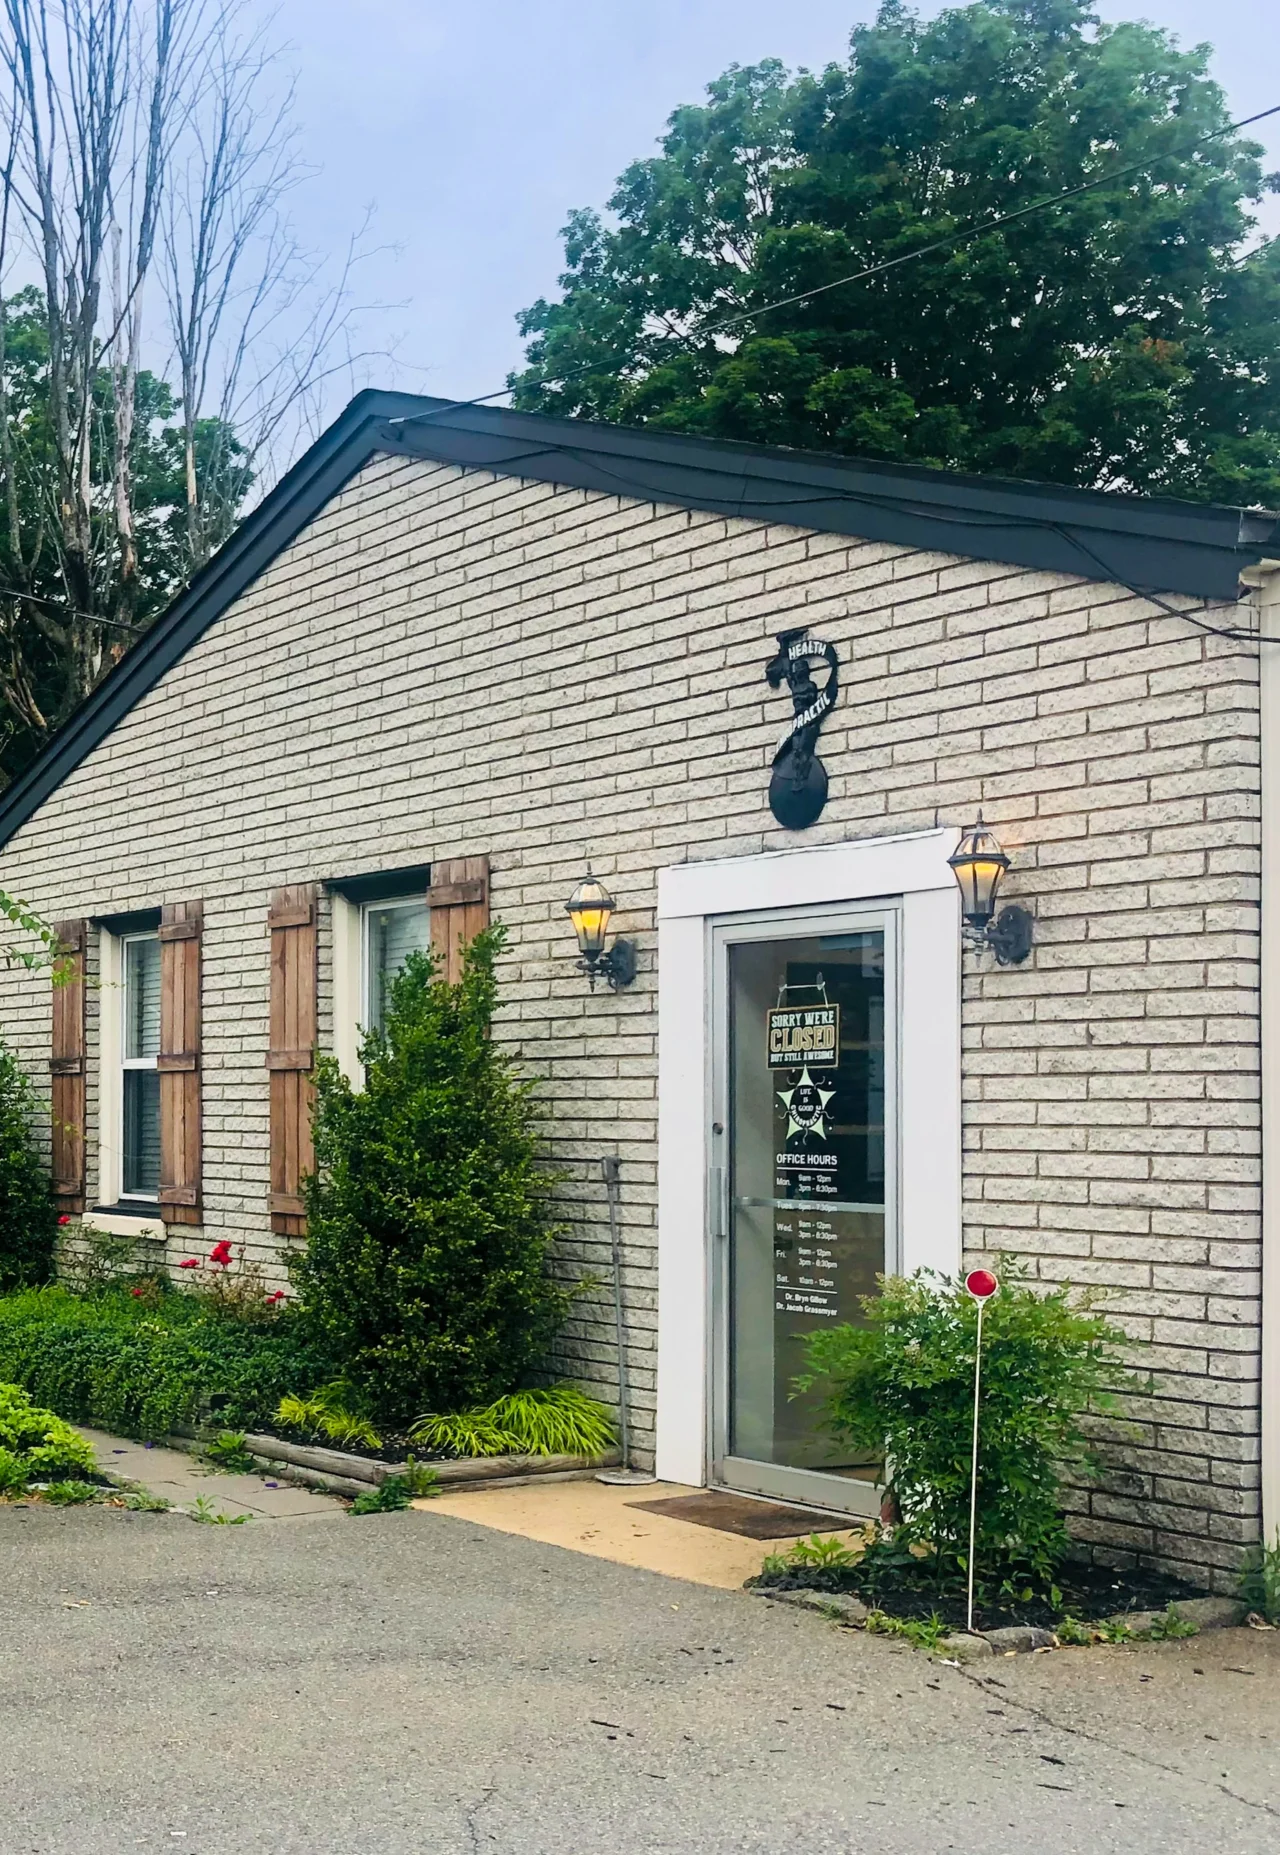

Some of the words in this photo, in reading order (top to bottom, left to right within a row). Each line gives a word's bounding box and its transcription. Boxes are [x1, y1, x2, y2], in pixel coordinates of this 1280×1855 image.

[788, 640, 827, 660] HEALTH
[771, 1013, 802, 1028] SORRY
[770, 1025, 835, 1053] CLOSED
[770, 1053, 783, 1063] BUT
[784, 1052, 802, 1062] STILL
[803, 1050, 834, 1061] AWESOME
[790, 1105, 822, 1127] CHIROPRACTIC
[776, 1153, 805, 1164] OFFICE
[807, 1155, 837, 1165] HOURS
[776, 1177, 791, 1186] Mon.
[776, 1223, 793, 1232] Wed.
[776, 1250, 787, 1258] Fri.
[776, 1302, 785, 1310] Dr.
